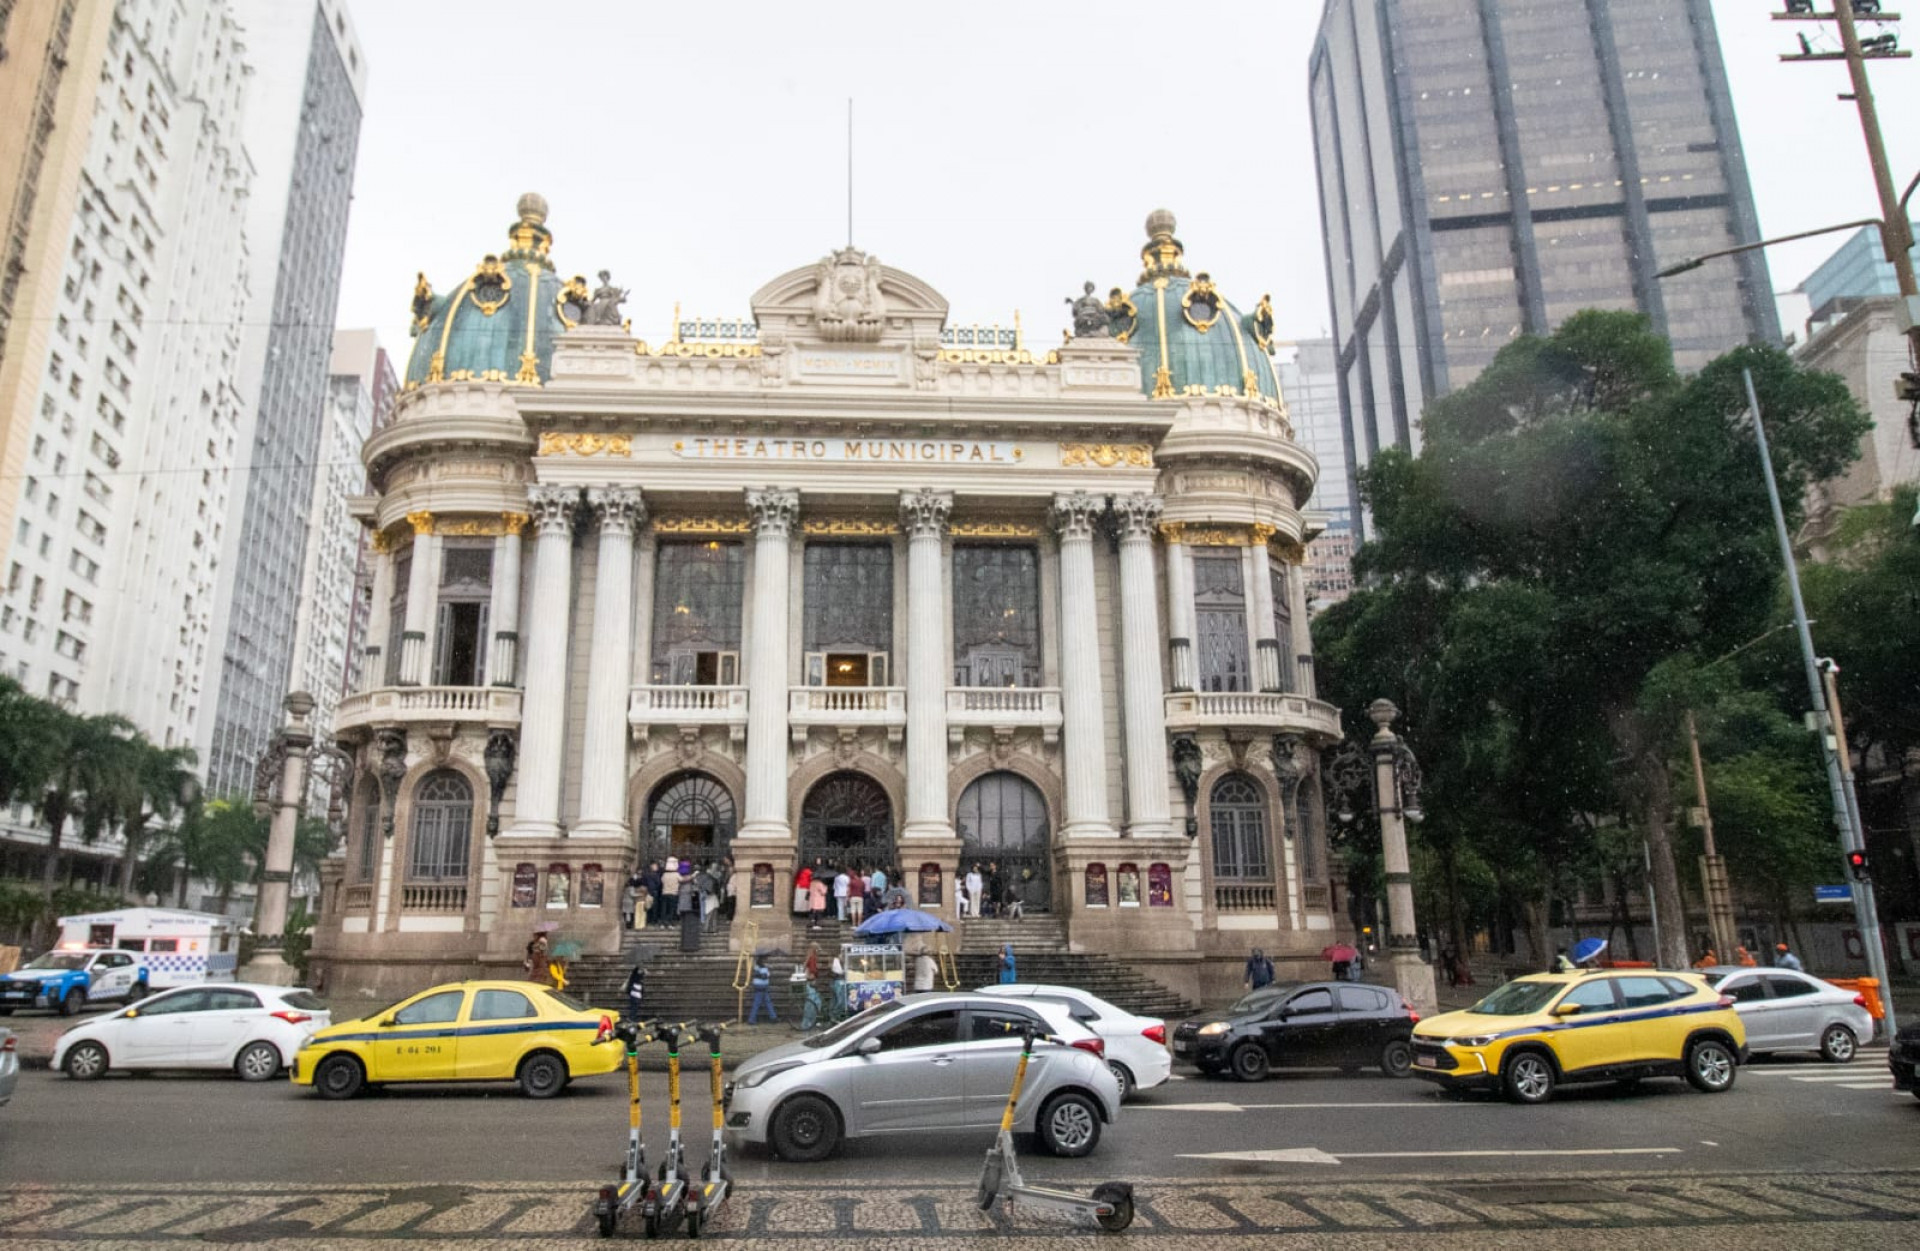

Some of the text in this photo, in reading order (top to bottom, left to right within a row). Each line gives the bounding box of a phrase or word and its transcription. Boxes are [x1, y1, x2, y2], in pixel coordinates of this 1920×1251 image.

[694, 438, 1004, 461] THEATRO MUNICIPAL
[860, 983, 892, 994] PIPOCA
